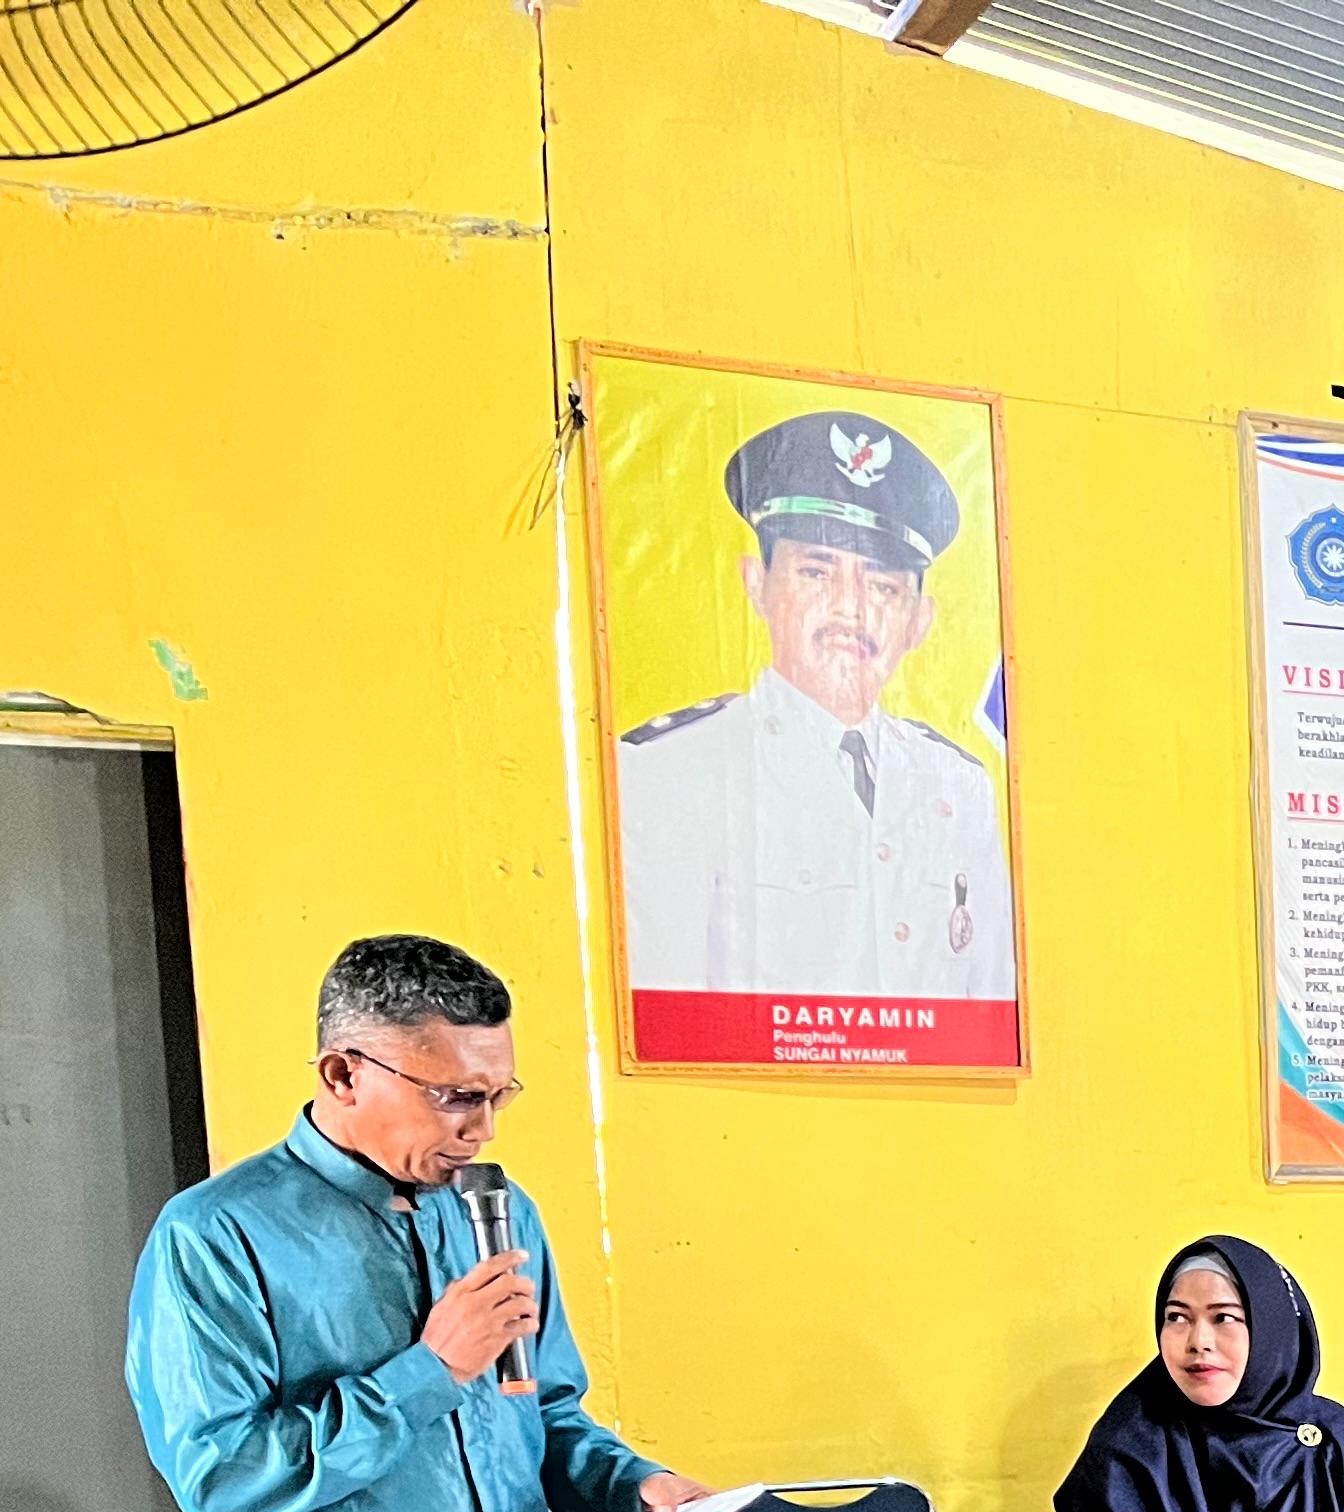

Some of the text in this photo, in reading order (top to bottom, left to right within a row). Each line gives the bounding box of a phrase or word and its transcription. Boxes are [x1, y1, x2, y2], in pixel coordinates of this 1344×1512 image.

[772, 1005, 935, 1028] DARYAMIN
[773, 1030, 846, 1045] Penghulu
[774, 1047, 908, 1062] SUNGAI NYAMUK
